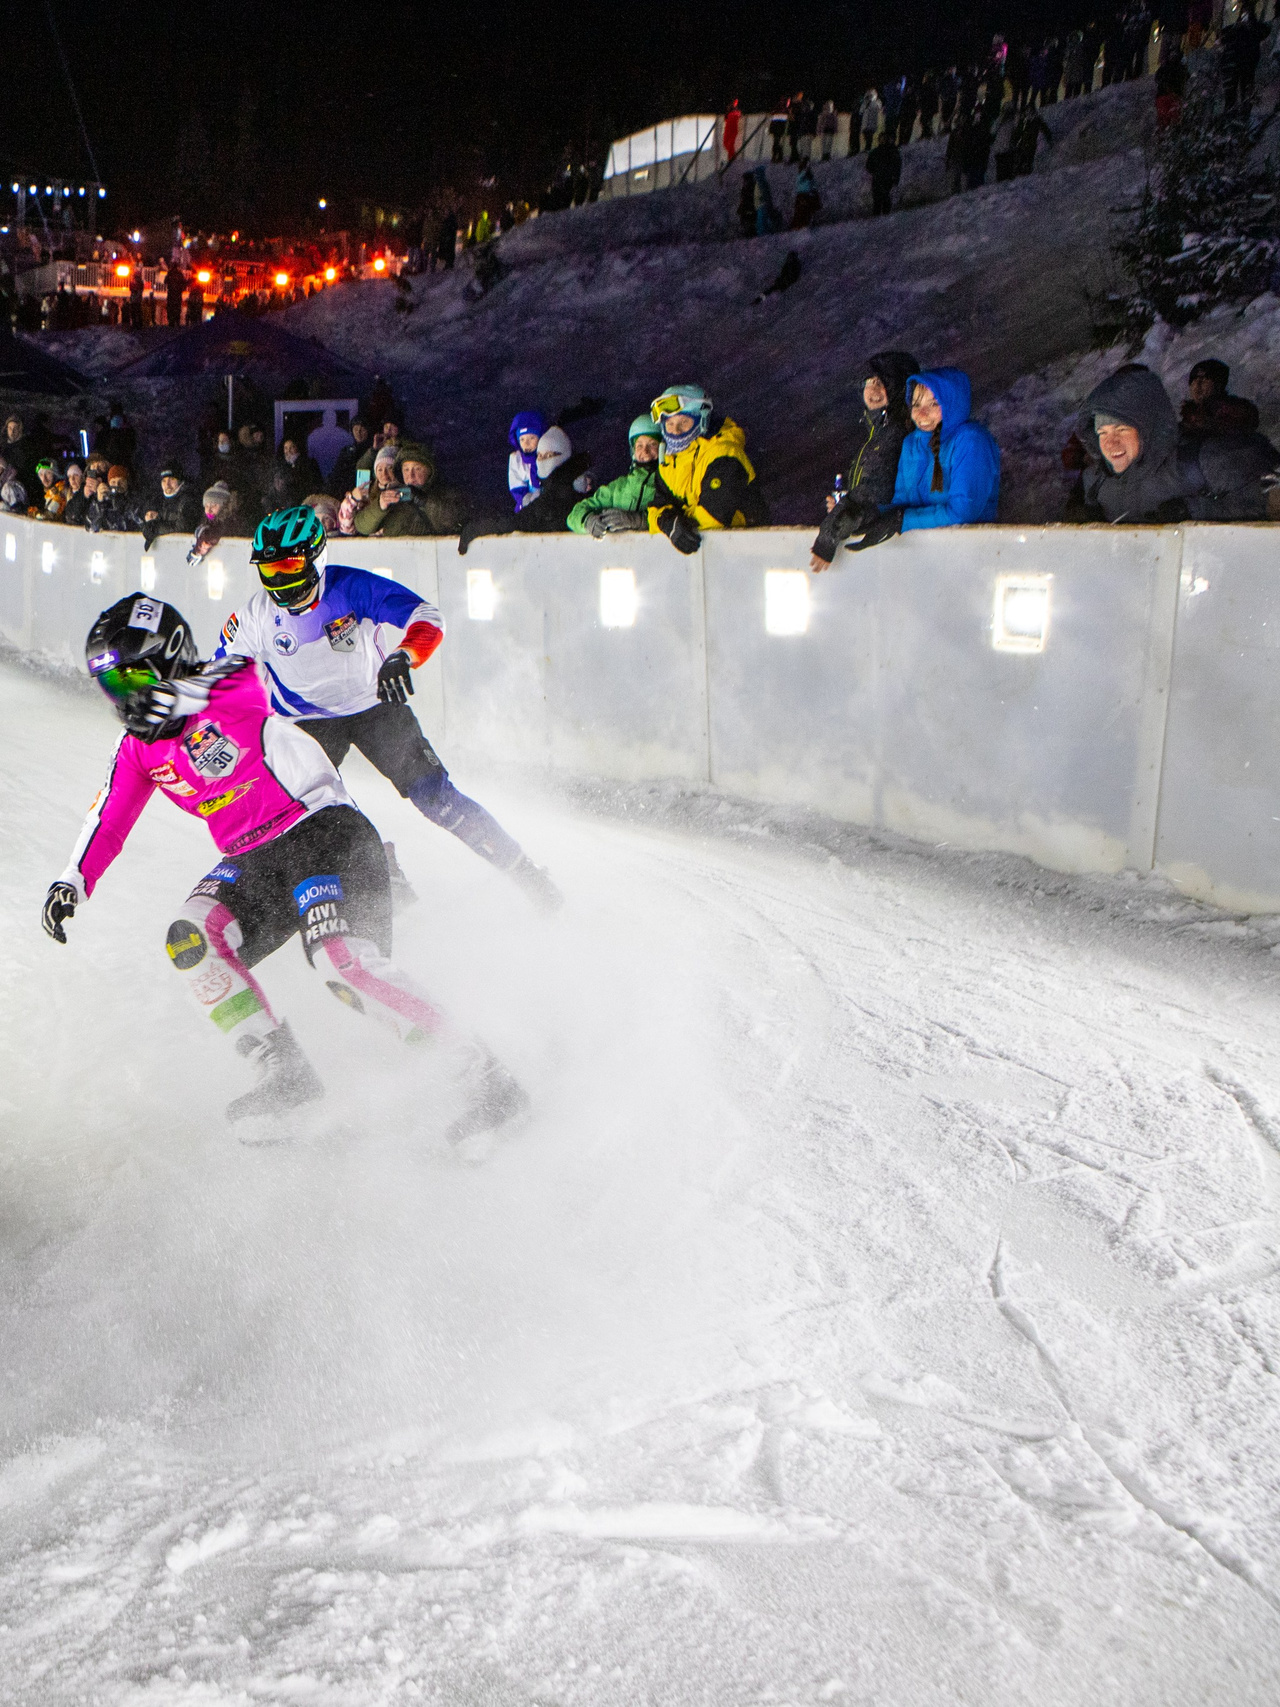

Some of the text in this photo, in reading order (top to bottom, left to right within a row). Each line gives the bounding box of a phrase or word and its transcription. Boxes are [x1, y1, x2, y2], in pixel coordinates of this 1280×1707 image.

[137, 604, 154, 620] 30
[345, 637, 354, 646] 4
[211, 750, 234, 769] 30
[308, 903, 337, 925] KIVI
[306, 917, 349, 945] PEKKA
